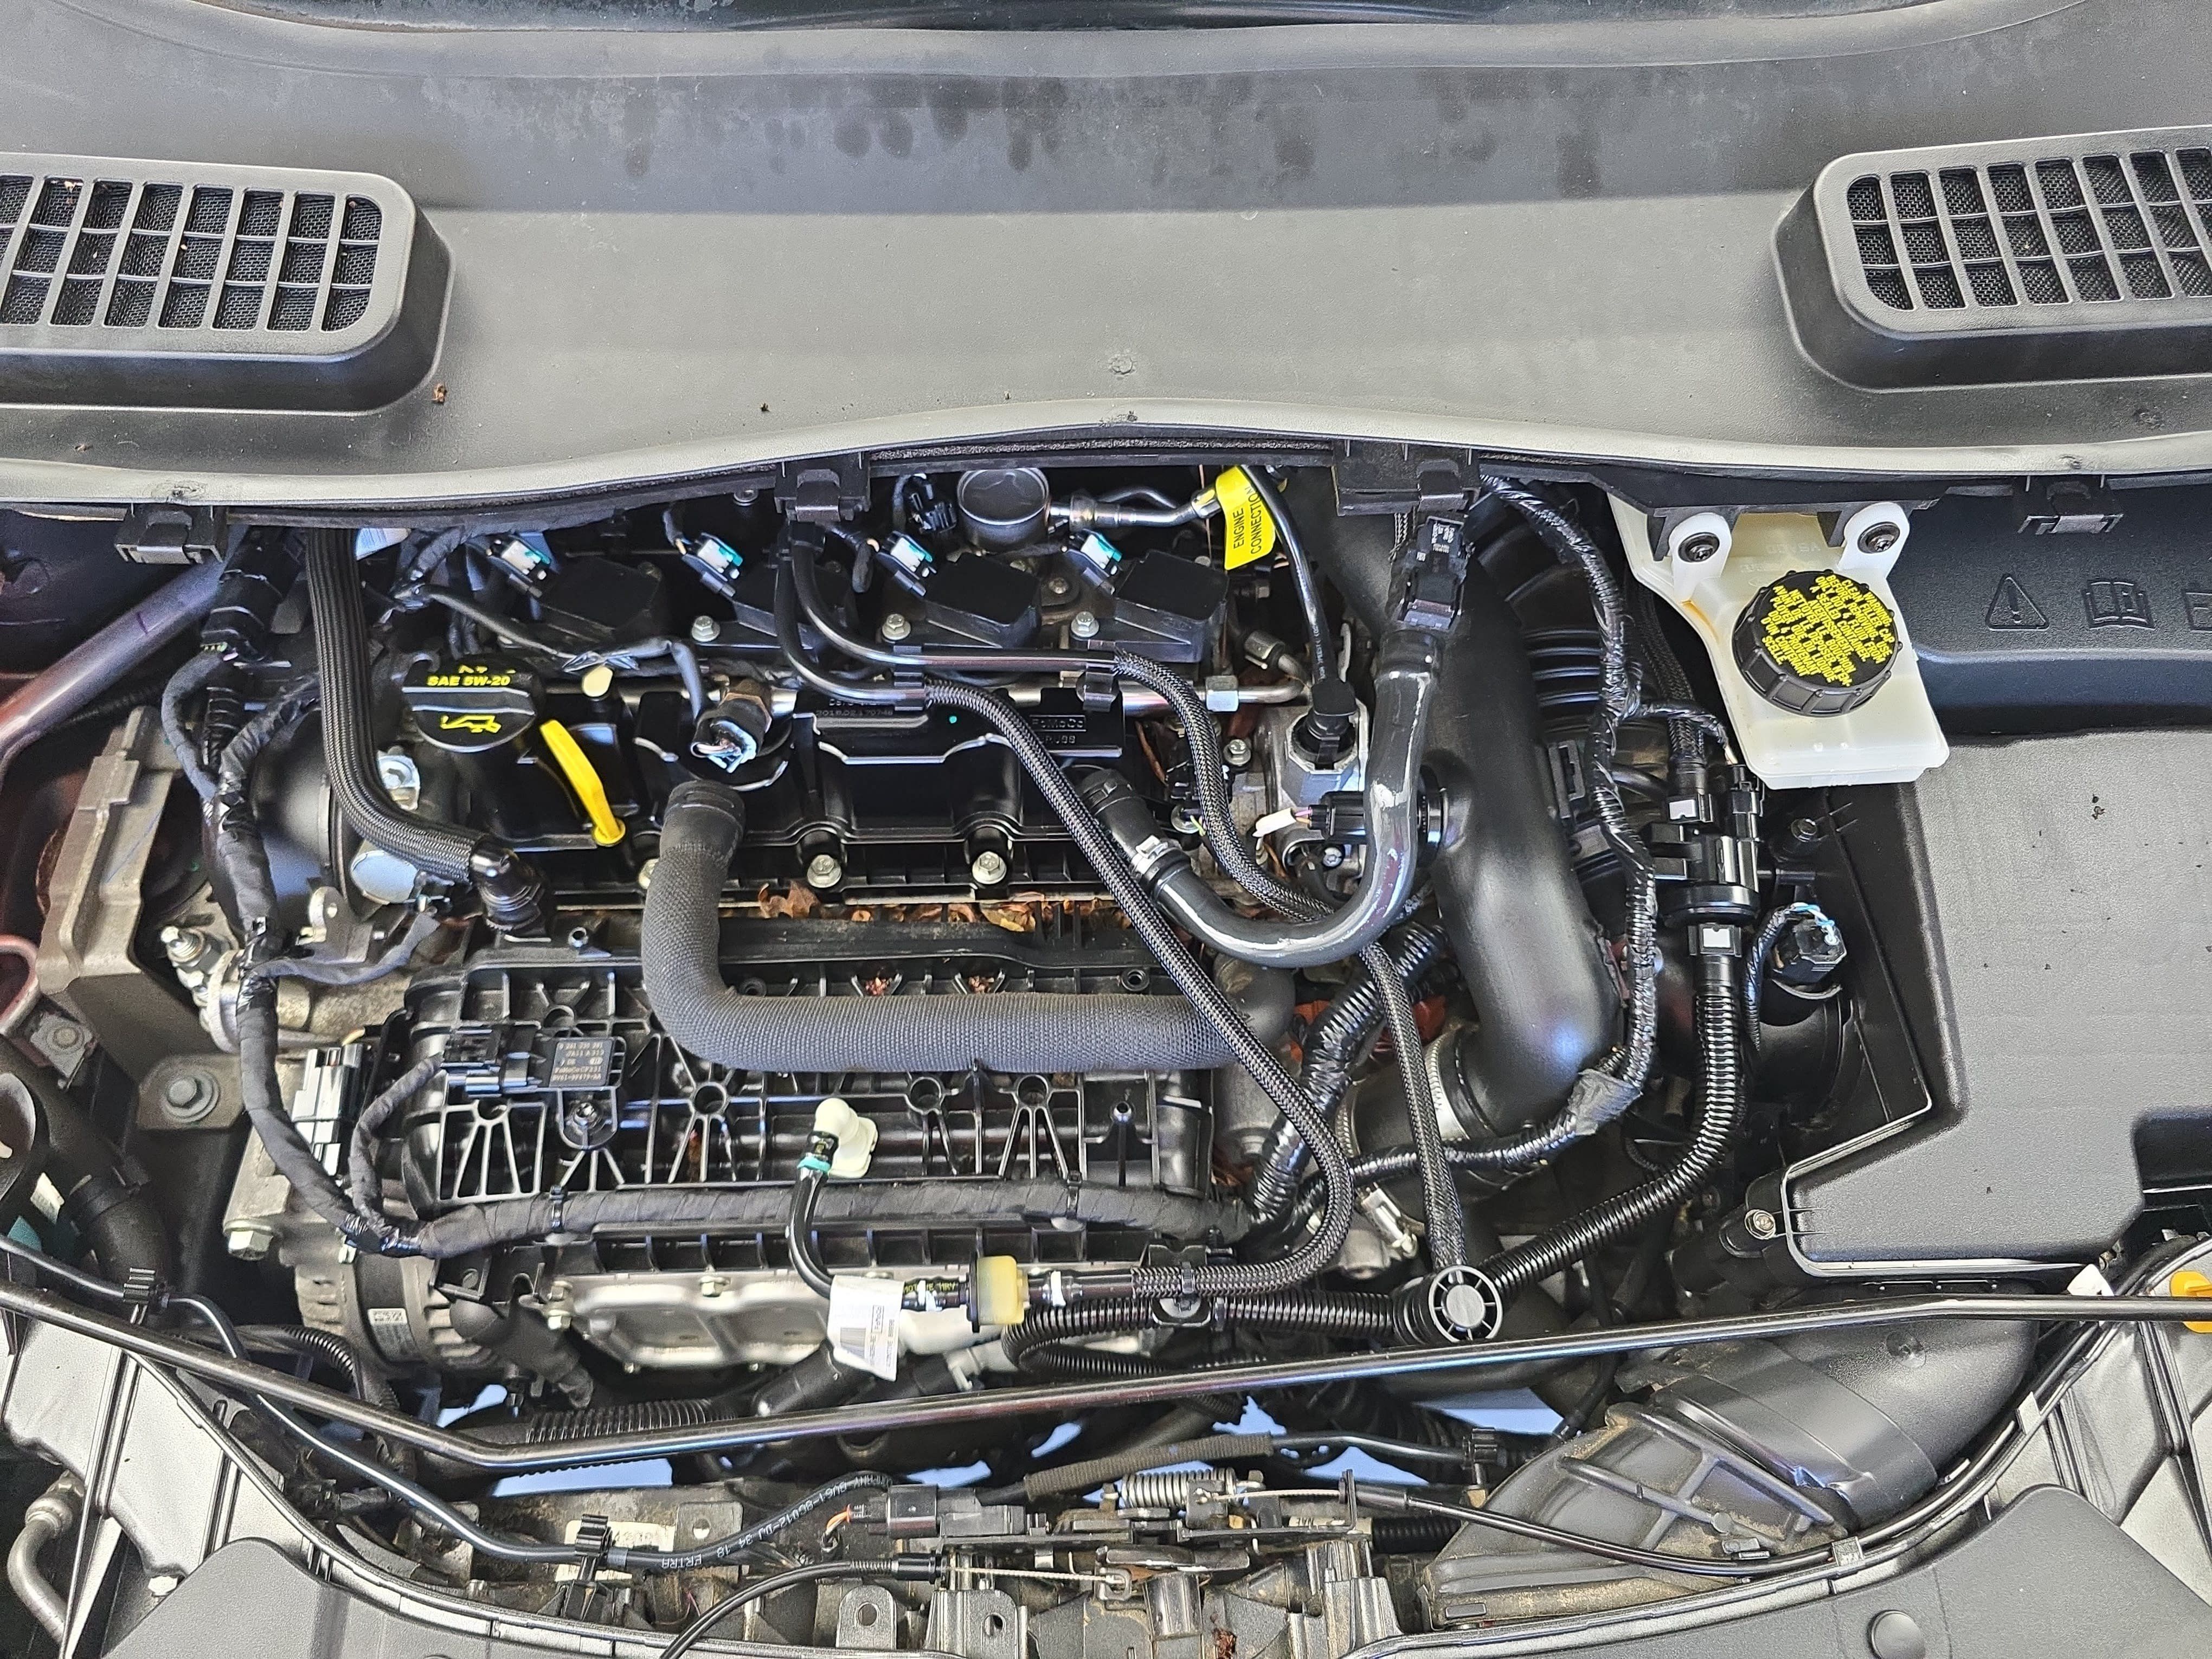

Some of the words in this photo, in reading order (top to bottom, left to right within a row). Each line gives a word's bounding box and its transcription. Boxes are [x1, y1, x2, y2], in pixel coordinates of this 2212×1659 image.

[1233, 507, 1244, 549] ENGINE
[1770, 597, 1795, 624] PLOYER
[1791, 625, 1807, 639] QUE
[1803, 640, 1816, 652] DU
[1812, 653, 1837, 683] LIQUIDE
[1773, 586, 1796, 607] AVANT
[1792, 608, 1804, 620] DE
[1799, 620, 1813, 631] LE
[1790, 589, 1819, 624] NETTOYER
[1816, 626, 1829, 635] LE
[1825, 639, 1856, 673] BOUCHON
[1816, 577, 1835, 595] ONLY
[1830, 596, 1847, 609] DOT
[1848, 619, 1868, 640] FLUID
[1864, 642, 1885, 664] FROM
[1817, 594, 1841, 620] SEALED
[1837, 621, 1870, 662] CONTAINER.
[1825, 575, 1852, 601] BEFORE
[1848, 603, 1879, 641] REMOVING.
[1877, 641, 1893, 657] USE
[1842, 580, 1863, 602] CLEAN
[1860, 602, 1882, 627] FILLER
[1879, 629, 1895, 643] CAP
[1863, 592, 1892, 626] WARNING:
[1768, 611, 1785, 624] DOT
[1786, 633, 1821, 675] PROVENANT
[1775, 636, 1810, 676] CONTENANT
[427, 676, 460, 686] SAE
[464, 676, 511, 686] 5W-20
[1032, 718, 1084, 728] FoMoCo
